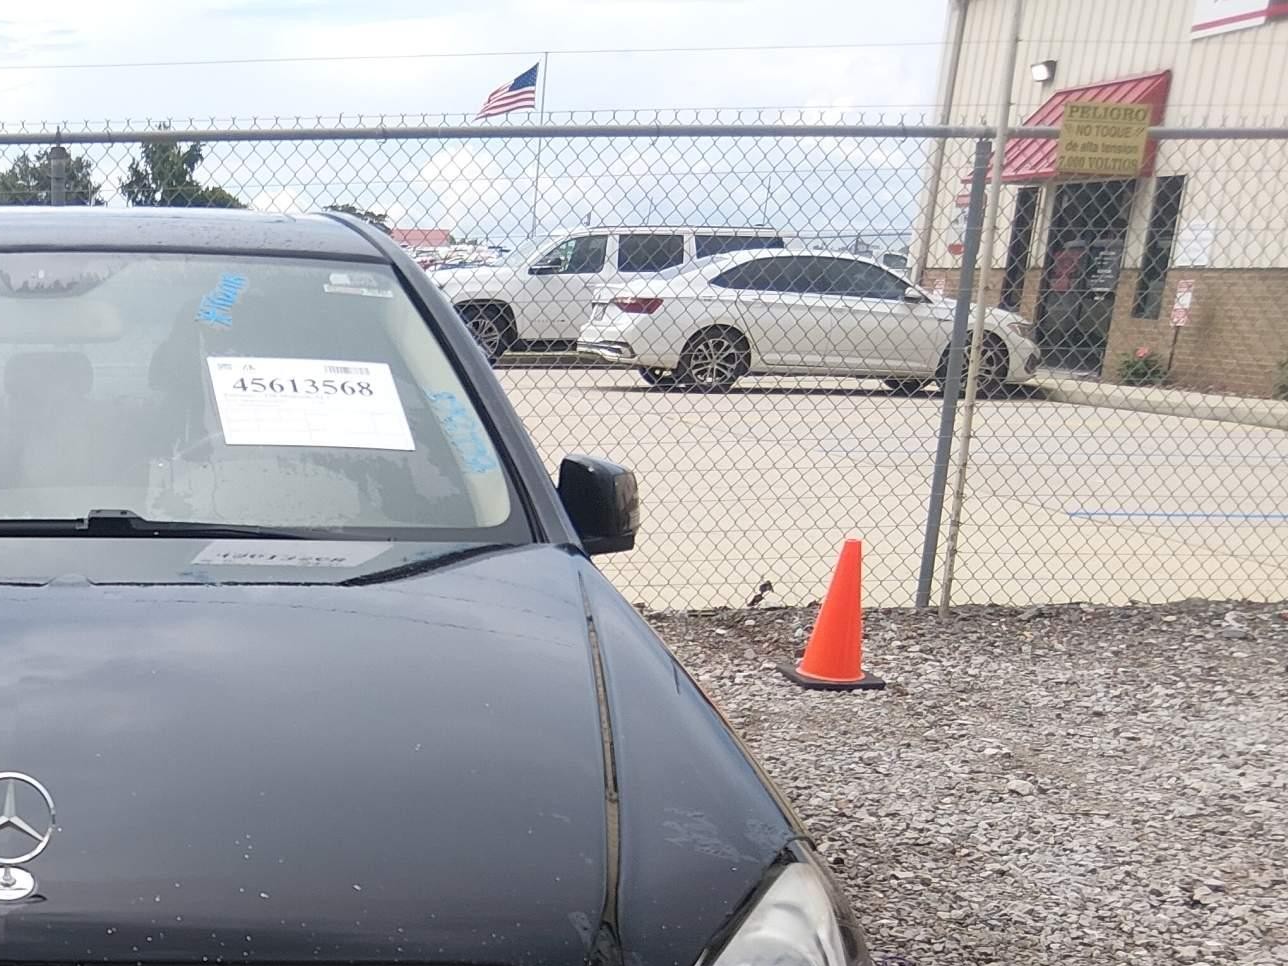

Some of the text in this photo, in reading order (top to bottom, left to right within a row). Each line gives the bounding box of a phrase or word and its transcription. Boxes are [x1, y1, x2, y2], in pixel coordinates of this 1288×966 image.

[1067, 105, 1147, 121] PELIGRO
[1076, 125, 1132, 138] NO TOQUE
[232, 376, 374, 397] 45613568
